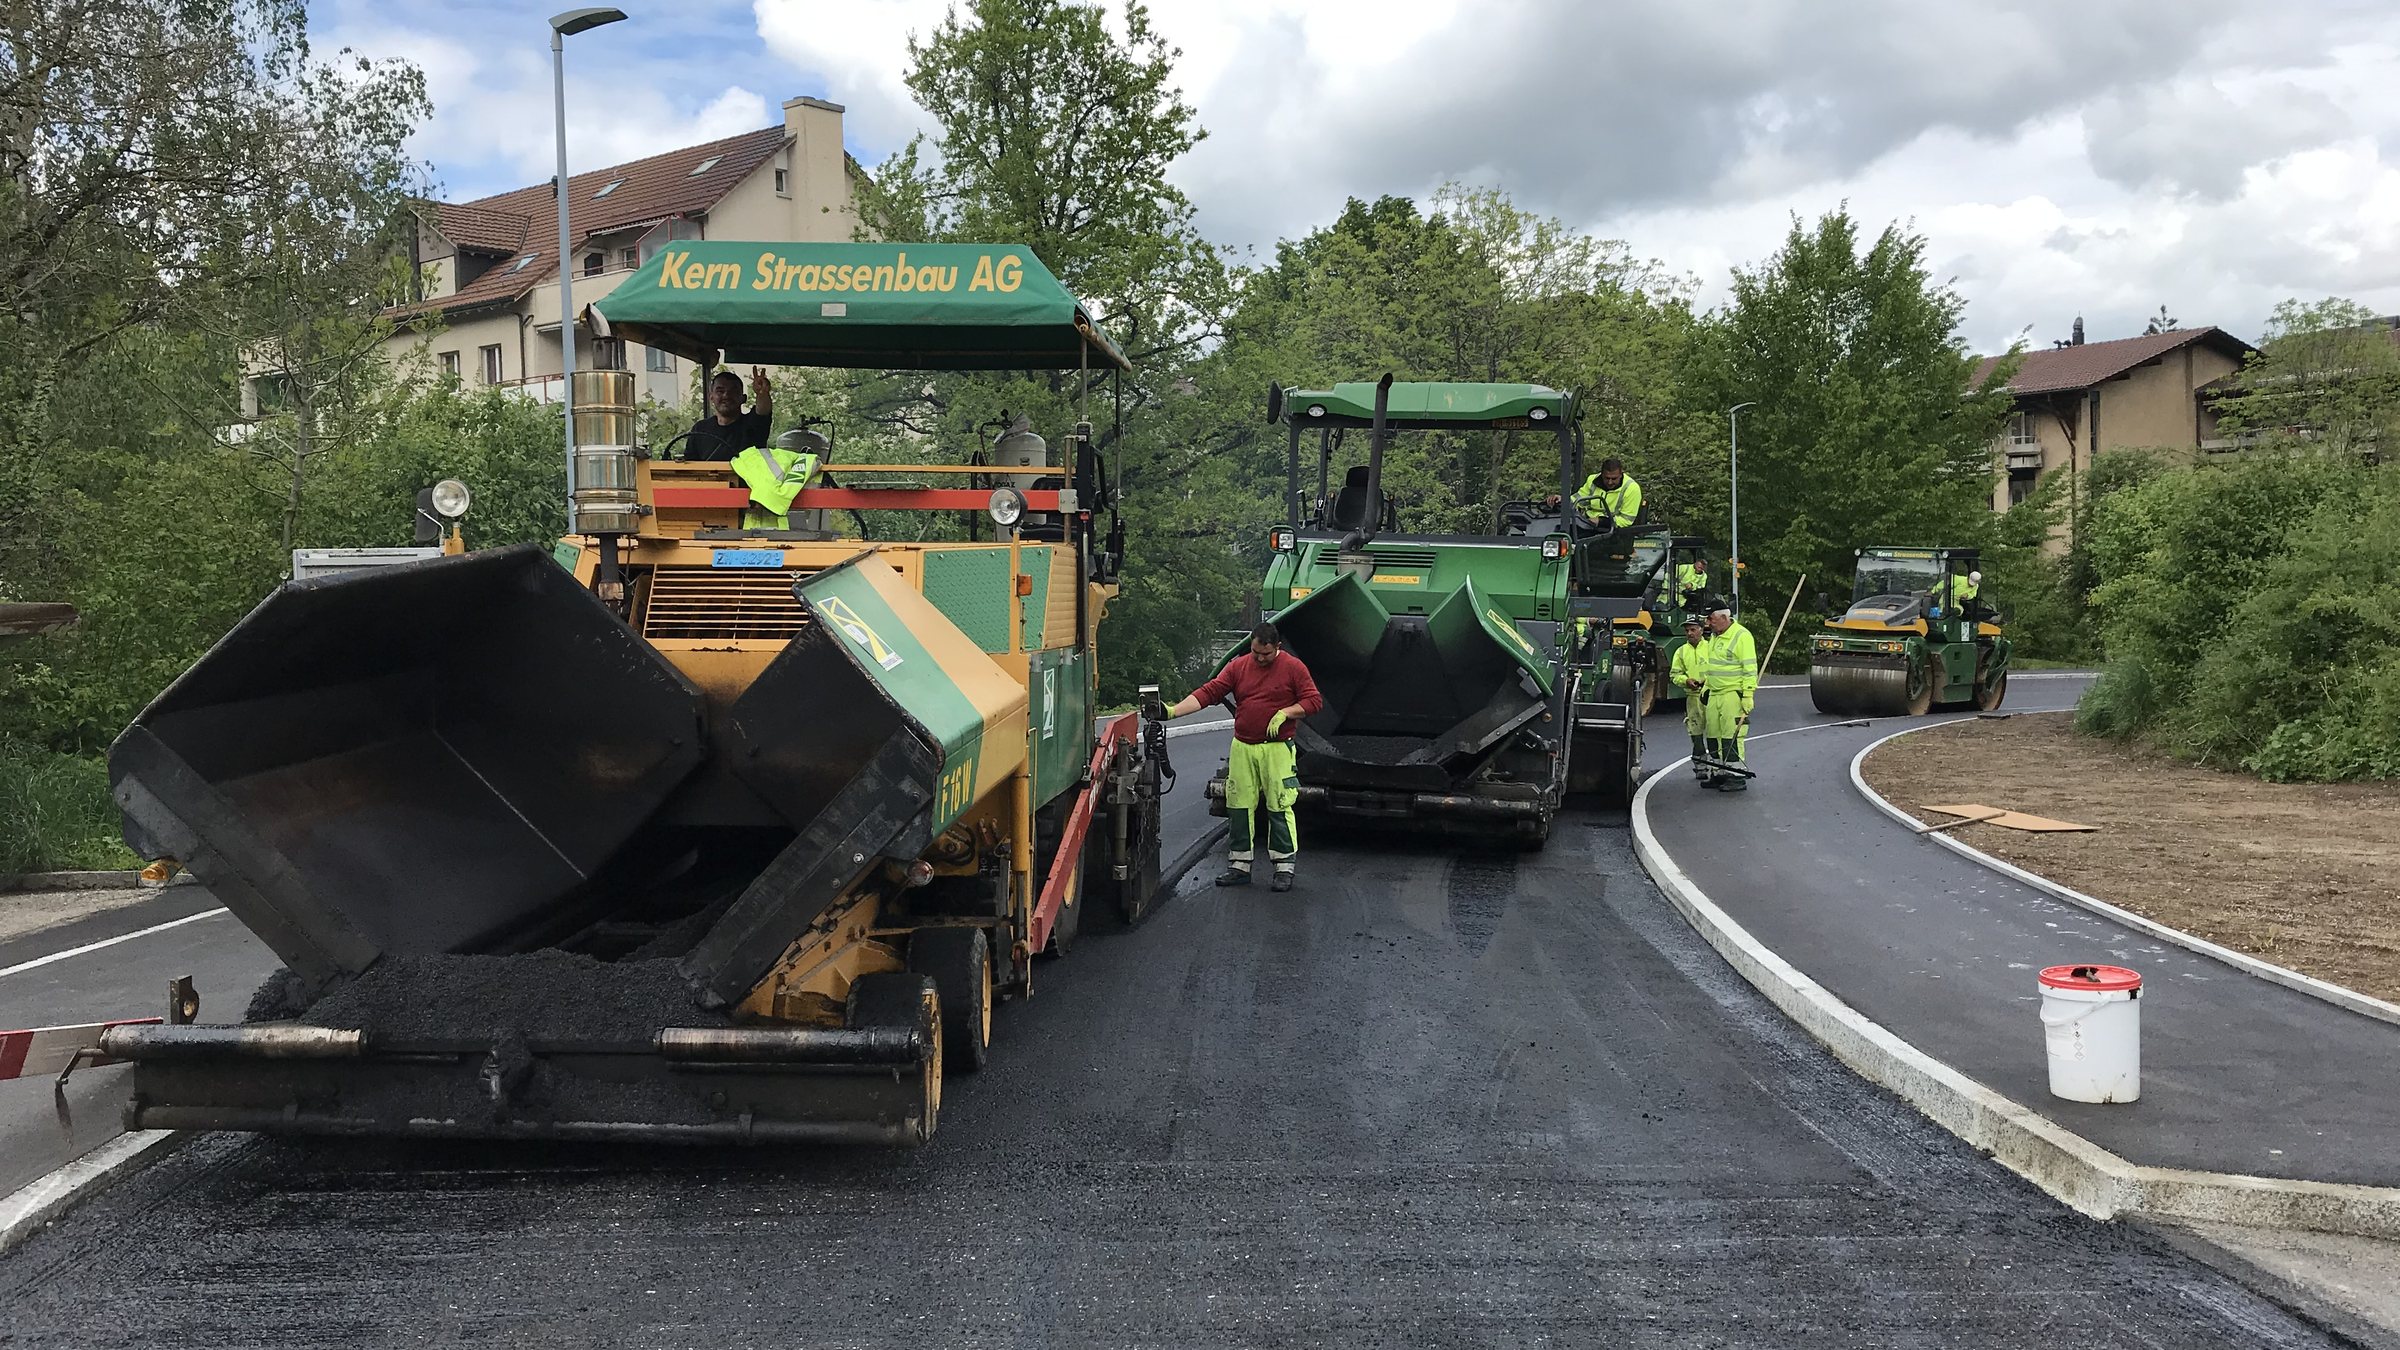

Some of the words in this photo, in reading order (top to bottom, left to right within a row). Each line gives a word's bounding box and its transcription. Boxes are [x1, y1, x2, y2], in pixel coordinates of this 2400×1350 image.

[658, 251, 742, 290] Kern
[751, 251, 958, 292] Strassenbau
[967, 254, 1024, 293] AG
[1876, 550, 1893, 558] Kern
